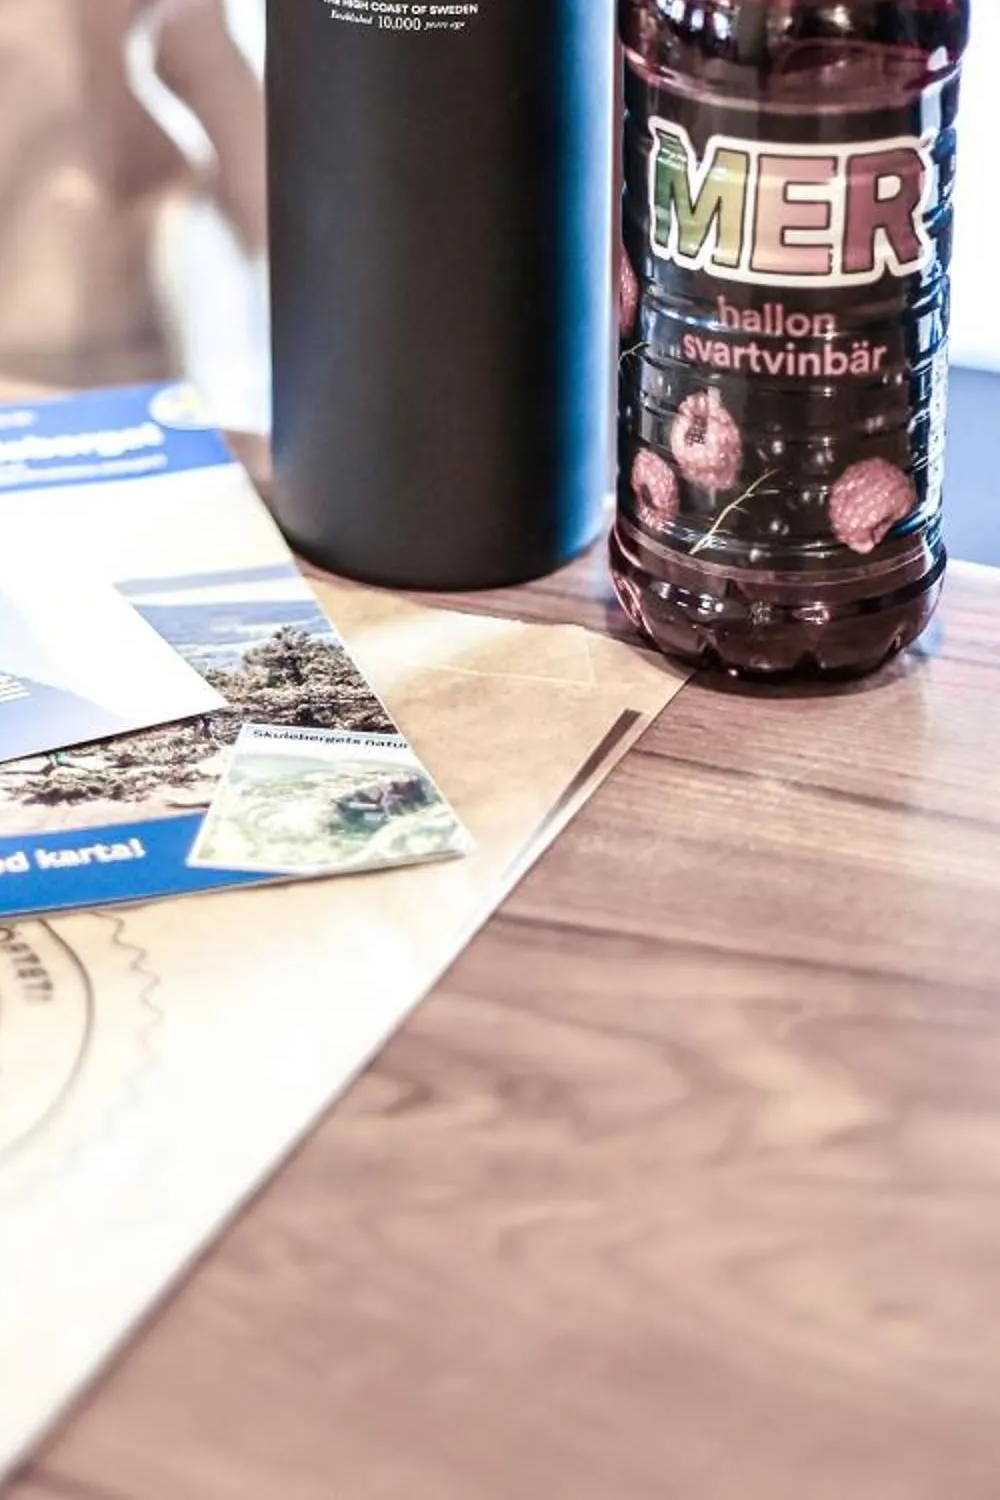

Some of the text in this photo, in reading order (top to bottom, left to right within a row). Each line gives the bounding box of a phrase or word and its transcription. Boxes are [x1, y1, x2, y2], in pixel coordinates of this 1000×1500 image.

[370, 2, 409, 15] COAST
[411, 4, 427, 15] OF
[429, 3, 479, 15] SWEDEN
[649, 117, 931, 286] MER
[718, 296, 836, 340] hallon
[683, 336, 887, 376] svartvinbär
[34, 837, 147, 870] karta!
